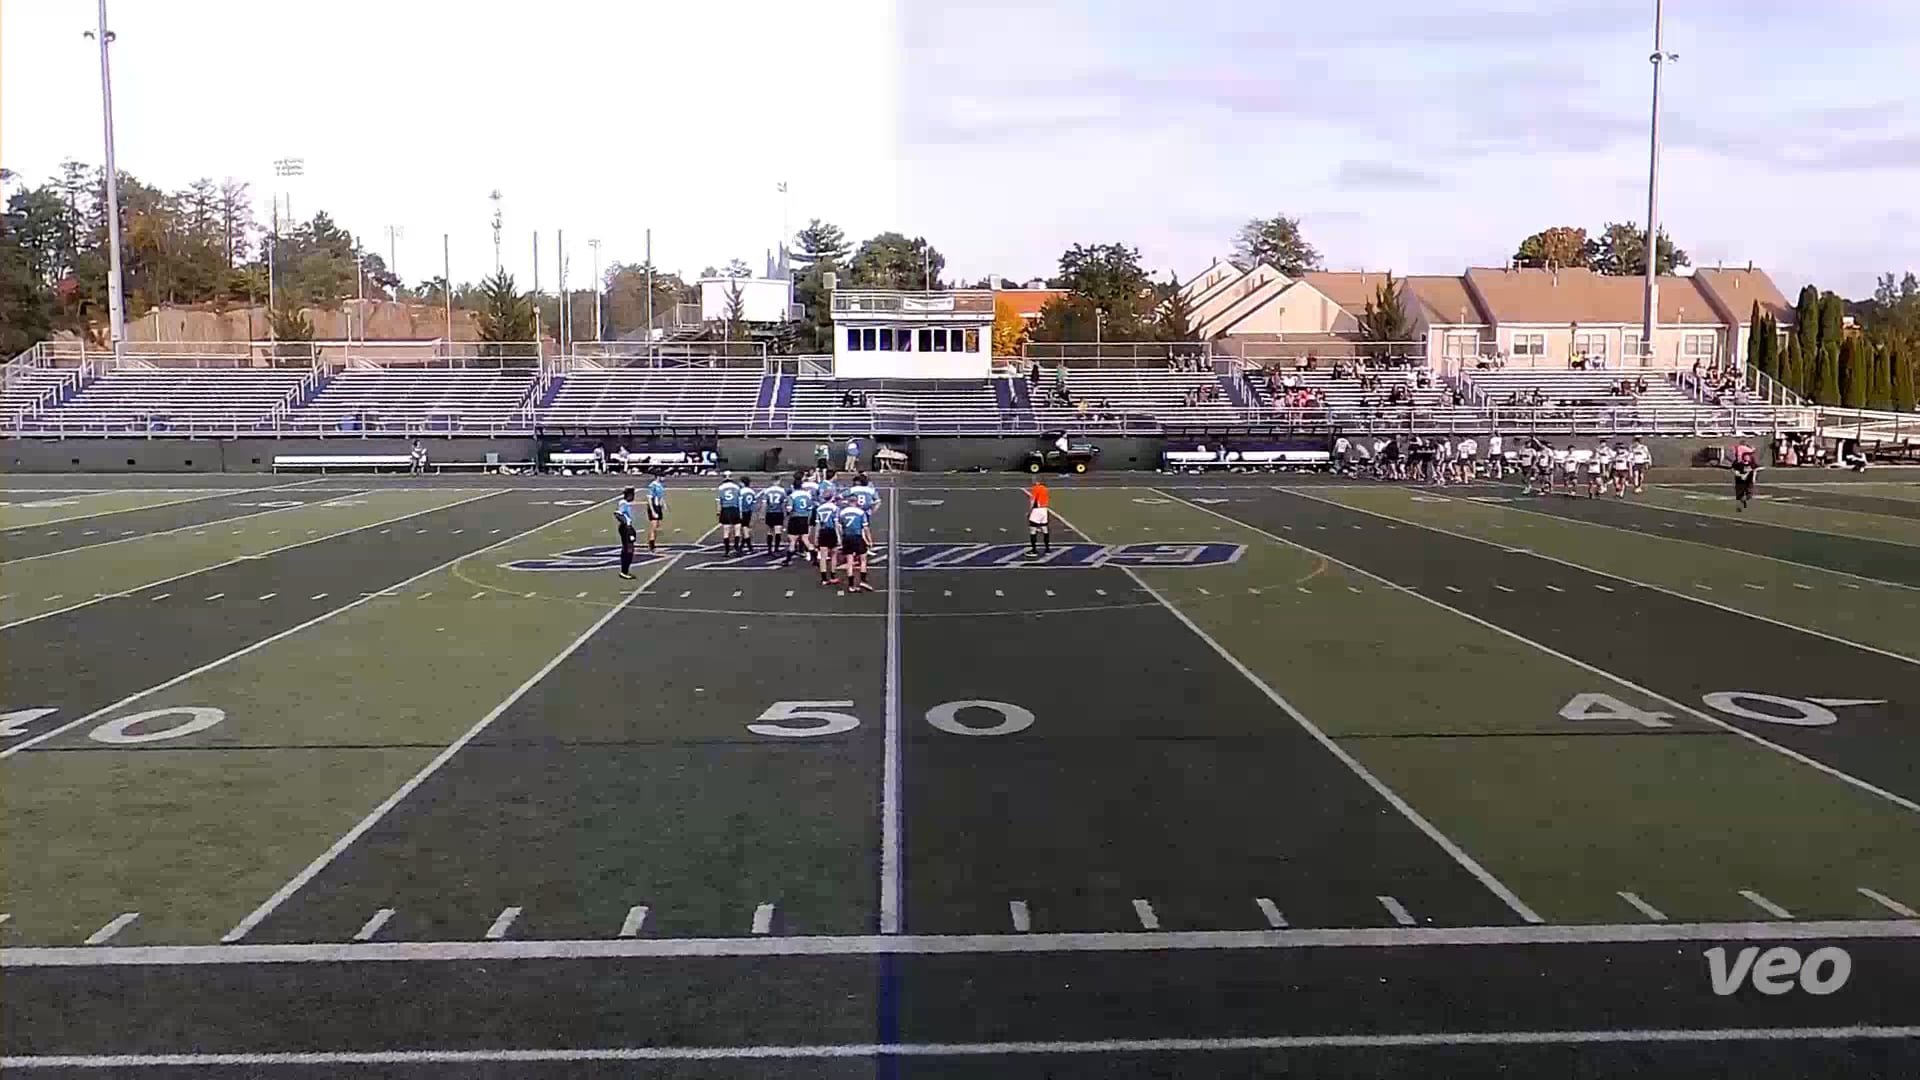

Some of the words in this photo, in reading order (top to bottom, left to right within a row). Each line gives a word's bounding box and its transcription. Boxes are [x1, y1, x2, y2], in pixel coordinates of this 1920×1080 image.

[724, 490, 734, 500] 5
[768, 493, 781, 504] 12
[857, 495, 866, 505] 8
[799, 498, 808, 509] 3
[845, 516, 856, 527] 7
